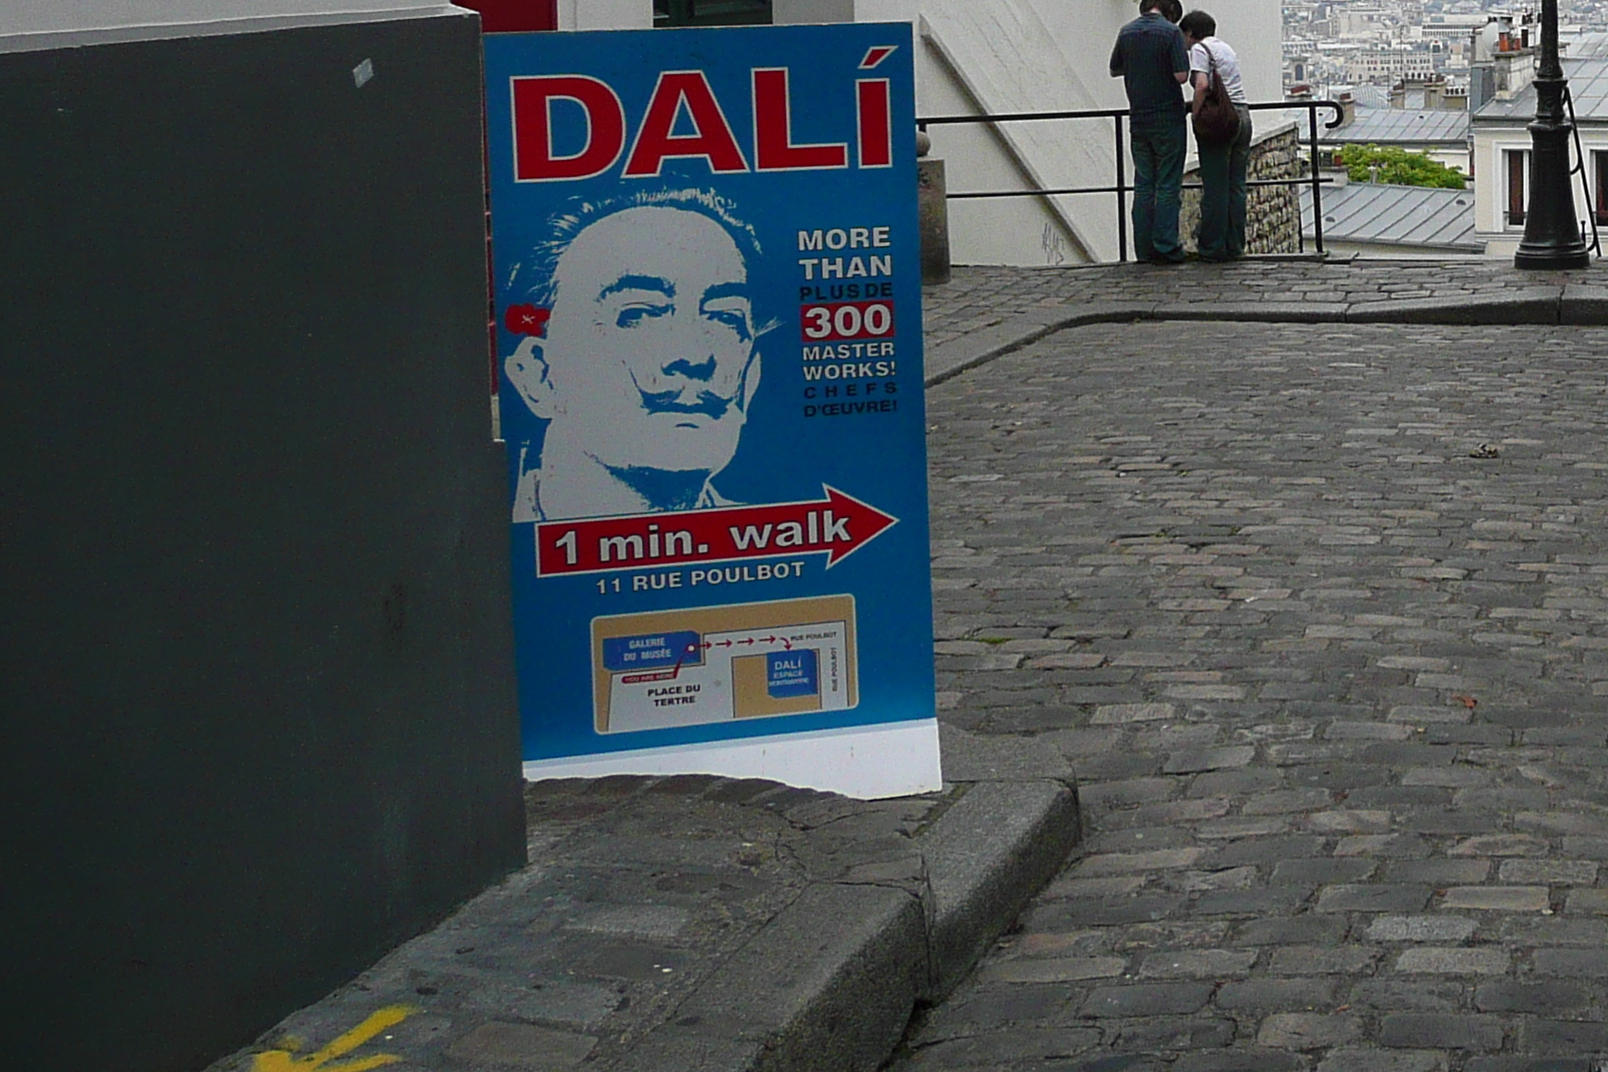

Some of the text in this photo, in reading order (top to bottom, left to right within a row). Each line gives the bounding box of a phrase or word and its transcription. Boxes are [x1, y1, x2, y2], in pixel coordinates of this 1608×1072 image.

[798, 227, 891, 251] MORE
[798, 255, 892, 280] THAN
[800, 282, 893, 301] PLUS DE
[804, 303, 892, 338] 300
[802, 342, 895, 361] MASTER
[803, 361, 896, 381] WORKS!
[555, 509, 851, 565] 1 min. walk
[596, 561, 805, 595] 11 RUE POULBOT
[628, 637, 666, 649] GALERIE
[623, 648, 672, 661] DU MUSÉE
[647, 684, 701, 697] PLACE DU
[653, 695, 696, 707] TERTRE
